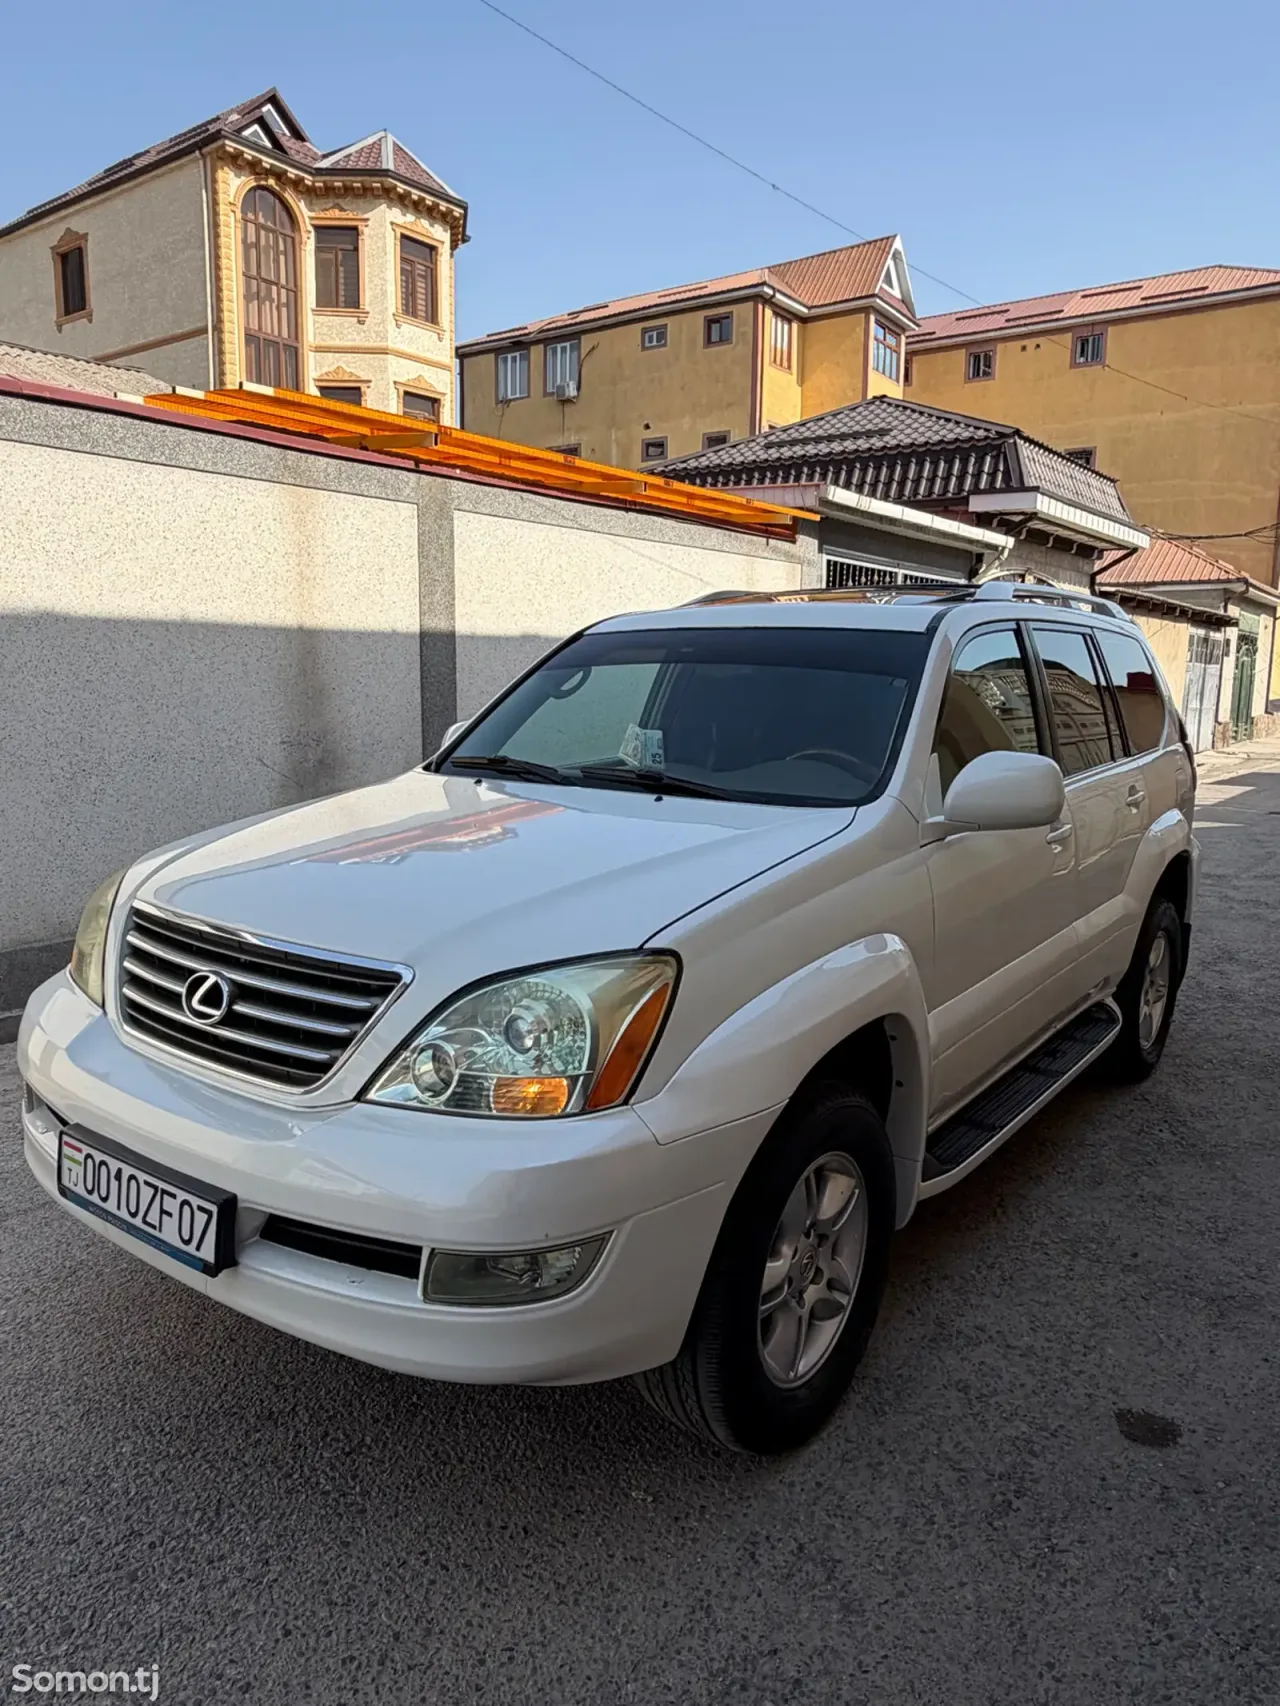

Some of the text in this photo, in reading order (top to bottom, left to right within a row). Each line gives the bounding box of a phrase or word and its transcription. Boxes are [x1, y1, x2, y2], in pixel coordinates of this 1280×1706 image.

[651, 753, 662, 765] 25
[67, 1167, 79, 1187] TJ
[83, 1152, 213, 1251] 0010ZF07
